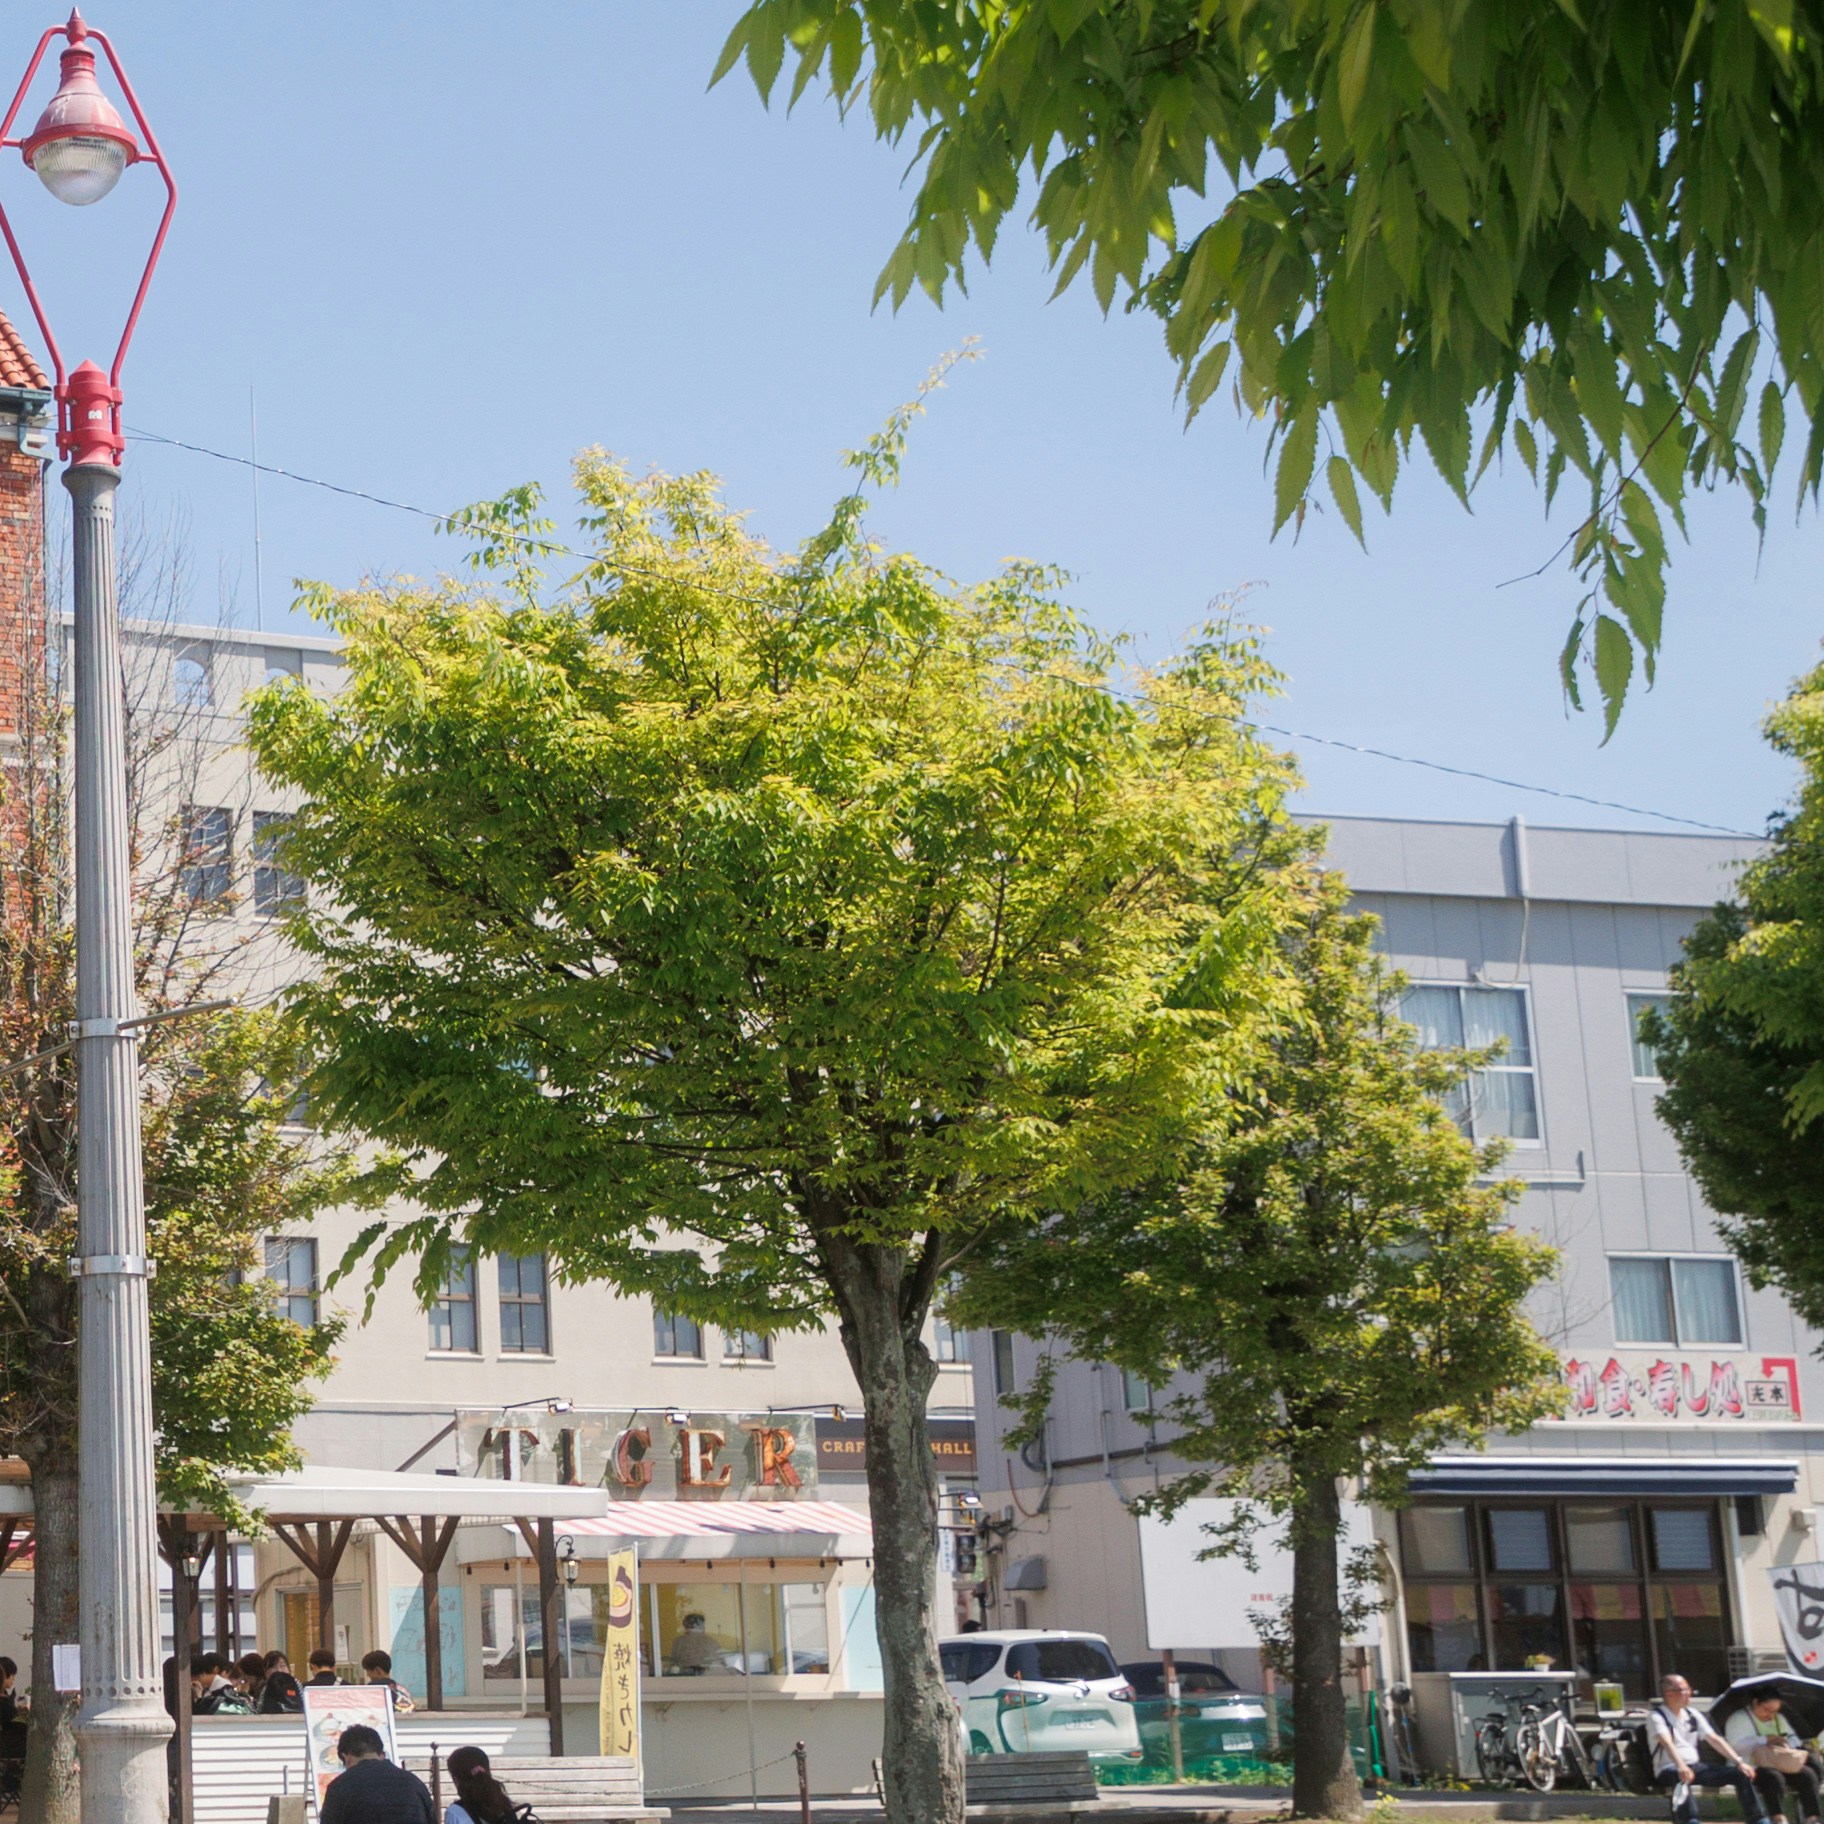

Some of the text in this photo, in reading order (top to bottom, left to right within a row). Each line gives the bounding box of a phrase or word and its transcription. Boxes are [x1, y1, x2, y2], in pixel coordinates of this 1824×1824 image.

[483, 1426, 805, 1487] TIGER
[822, 1440, 973, 1455] CRAF HALL
